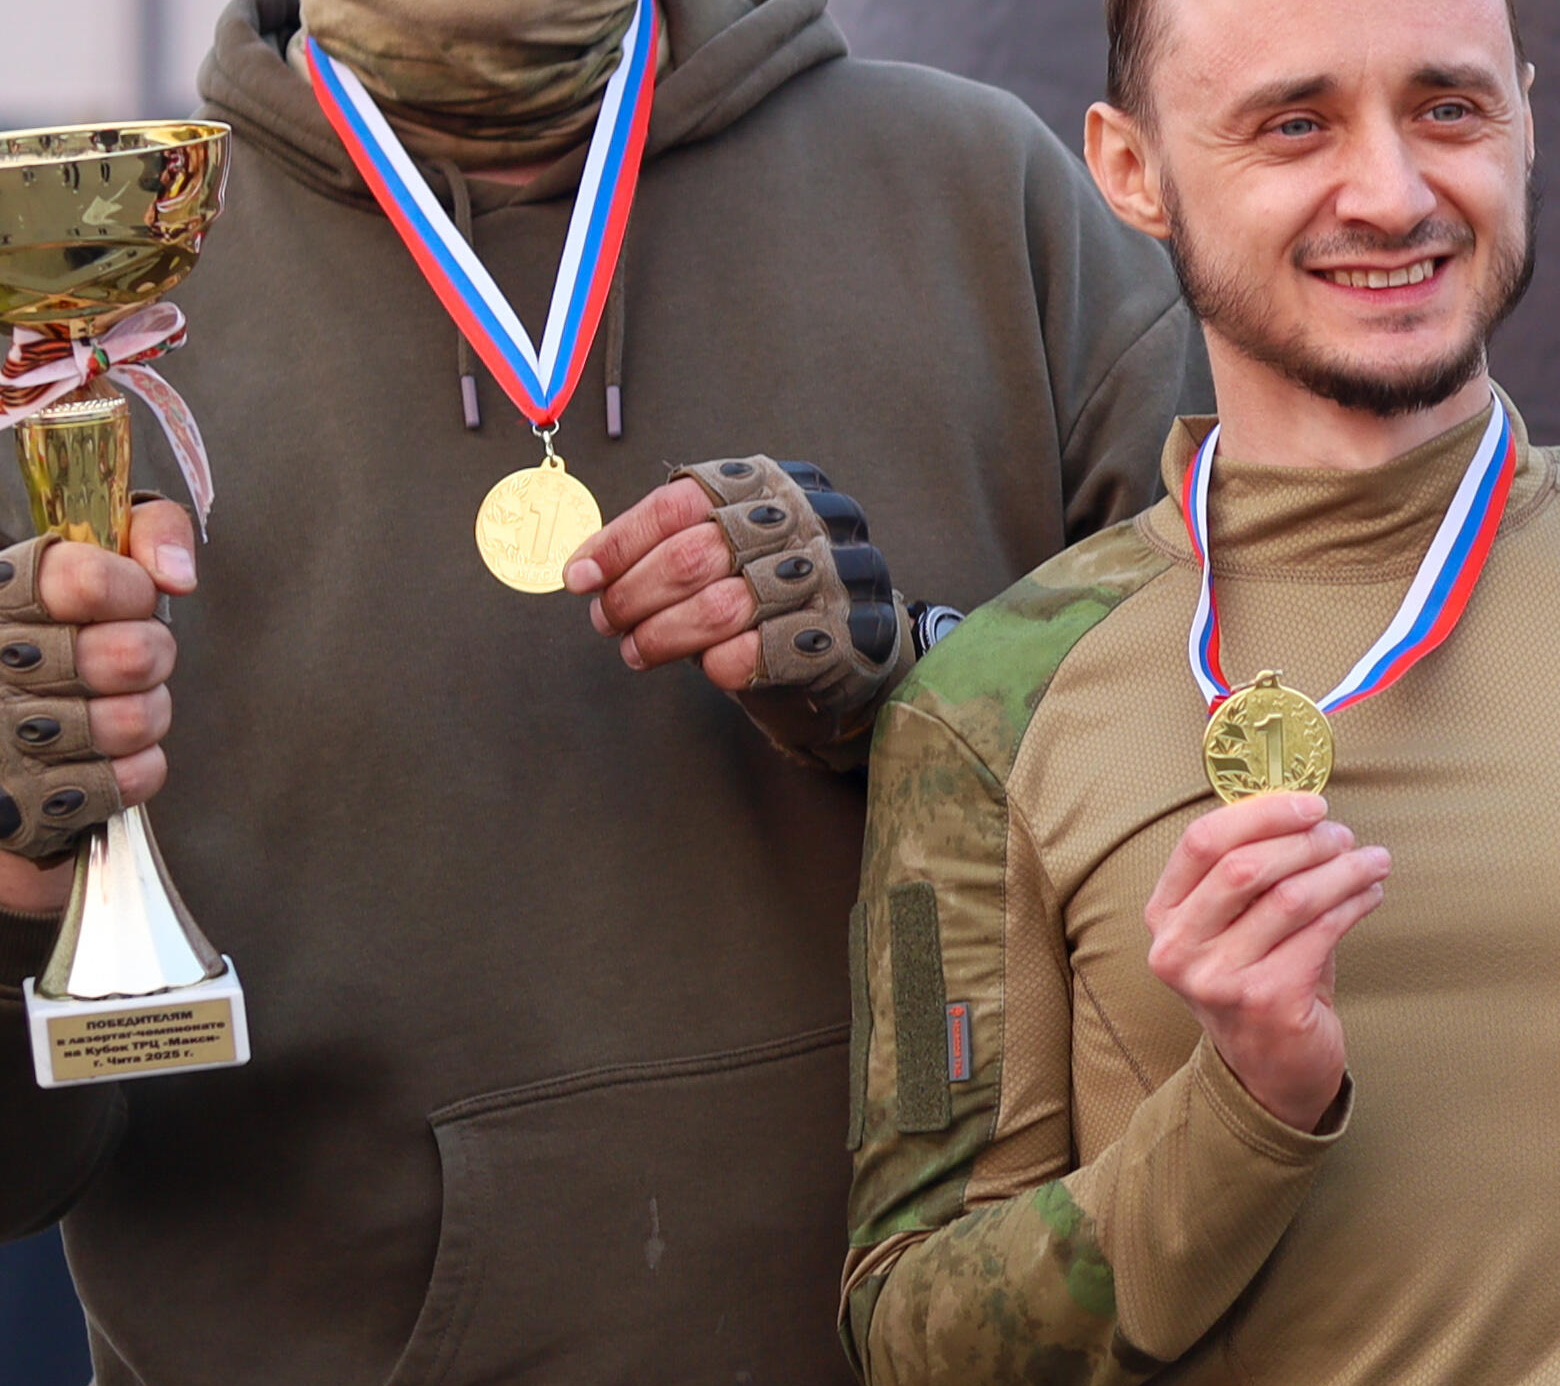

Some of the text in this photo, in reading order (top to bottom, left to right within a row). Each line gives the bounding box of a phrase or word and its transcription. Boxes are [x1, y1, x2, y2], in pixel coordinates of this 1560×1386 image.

[1253, 713, 1284, 788] 1
[86, 1011, 193, 1030] ПОБЕДИТЕЛЯМ
[56, 1038, 66, 1046] в
[64, 1050, 82, 1058] на
[85, 1042, 129, 1056] Кубок
[132, 1040, 160, 1052] ТРЦ
[93, 1049, 194, 1068] г. Чита 2025 г.
